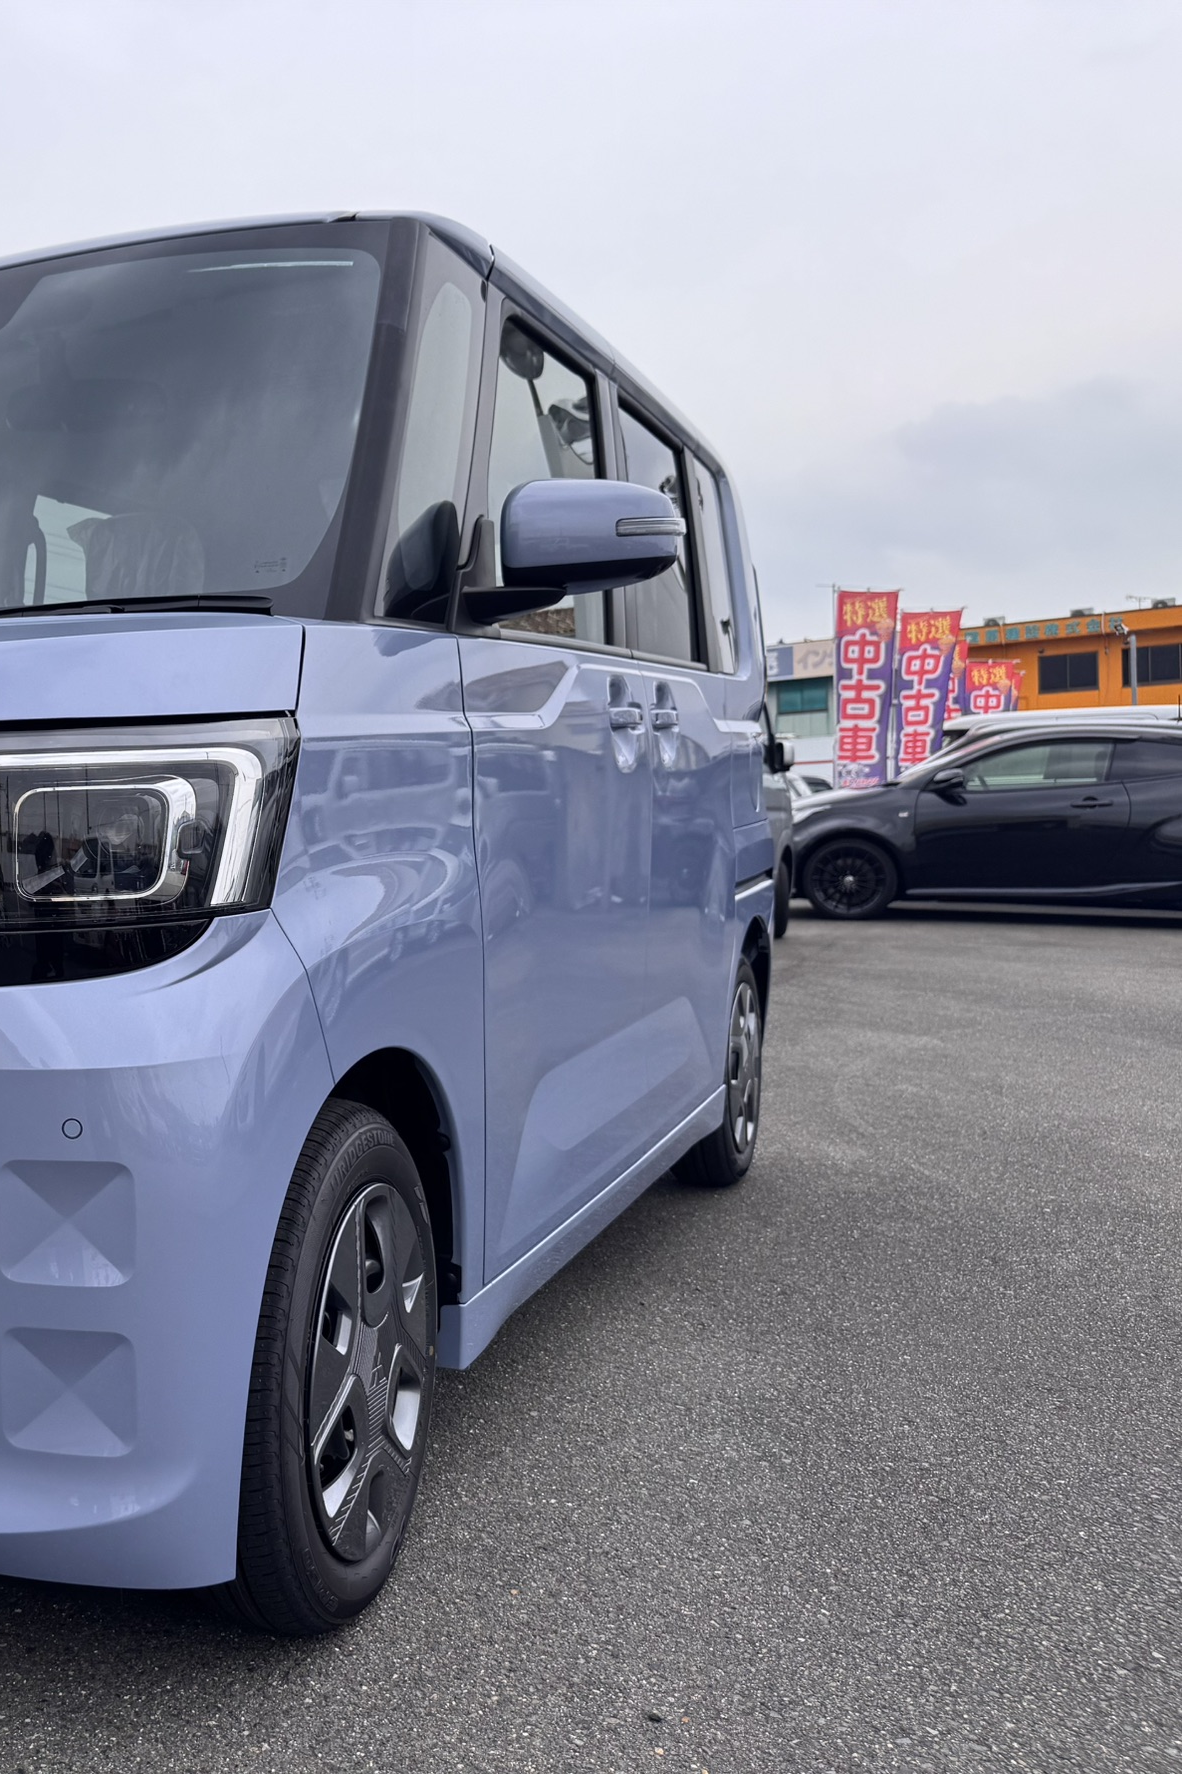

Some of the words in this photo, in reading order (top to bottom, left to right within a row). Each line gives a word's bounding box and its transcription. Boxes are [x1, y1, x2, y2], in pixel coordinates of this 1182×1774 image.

[843, 597, 888, 627] 特選
[907, 615, 951, 644] 特選
[971, 664, 1006, 687] 特選
[837, 631, 882, 763] 中古車
[899, 647, 942, 765] 中古車
